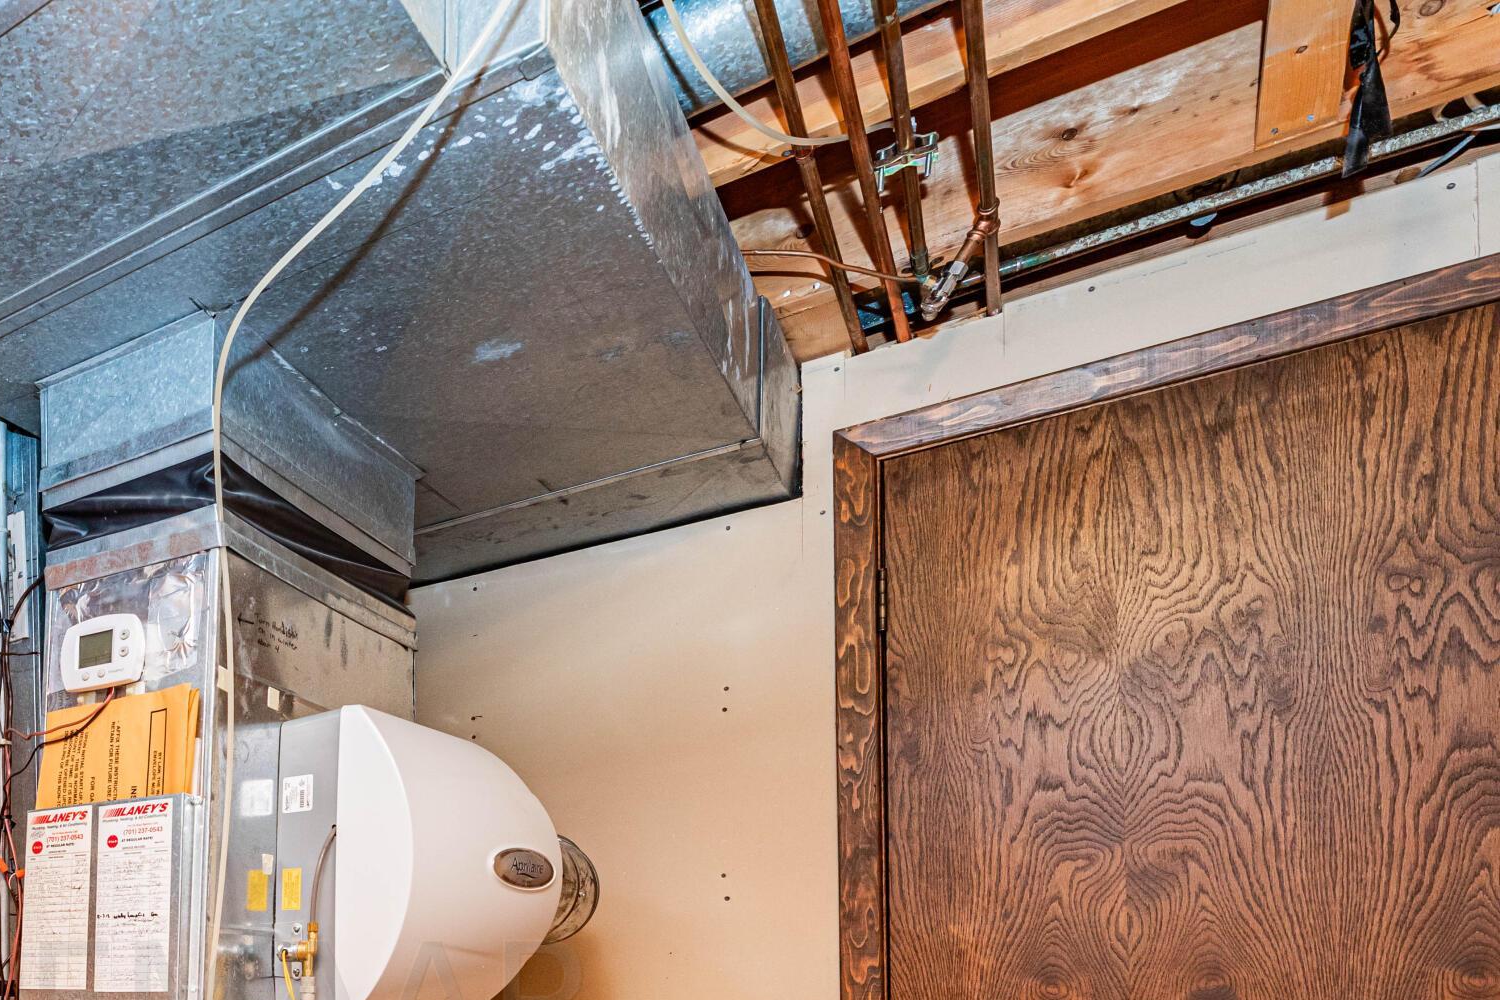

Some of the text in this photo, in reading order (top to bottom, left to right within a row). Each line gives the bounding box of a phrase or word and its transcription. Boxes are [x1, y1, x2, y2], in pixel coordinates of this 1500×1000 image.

[120, 803, 168, 816] LANEY'S
[45, 811, 88, 823] LANEY'S
[511, 857, 543, 875] Aprilaire
